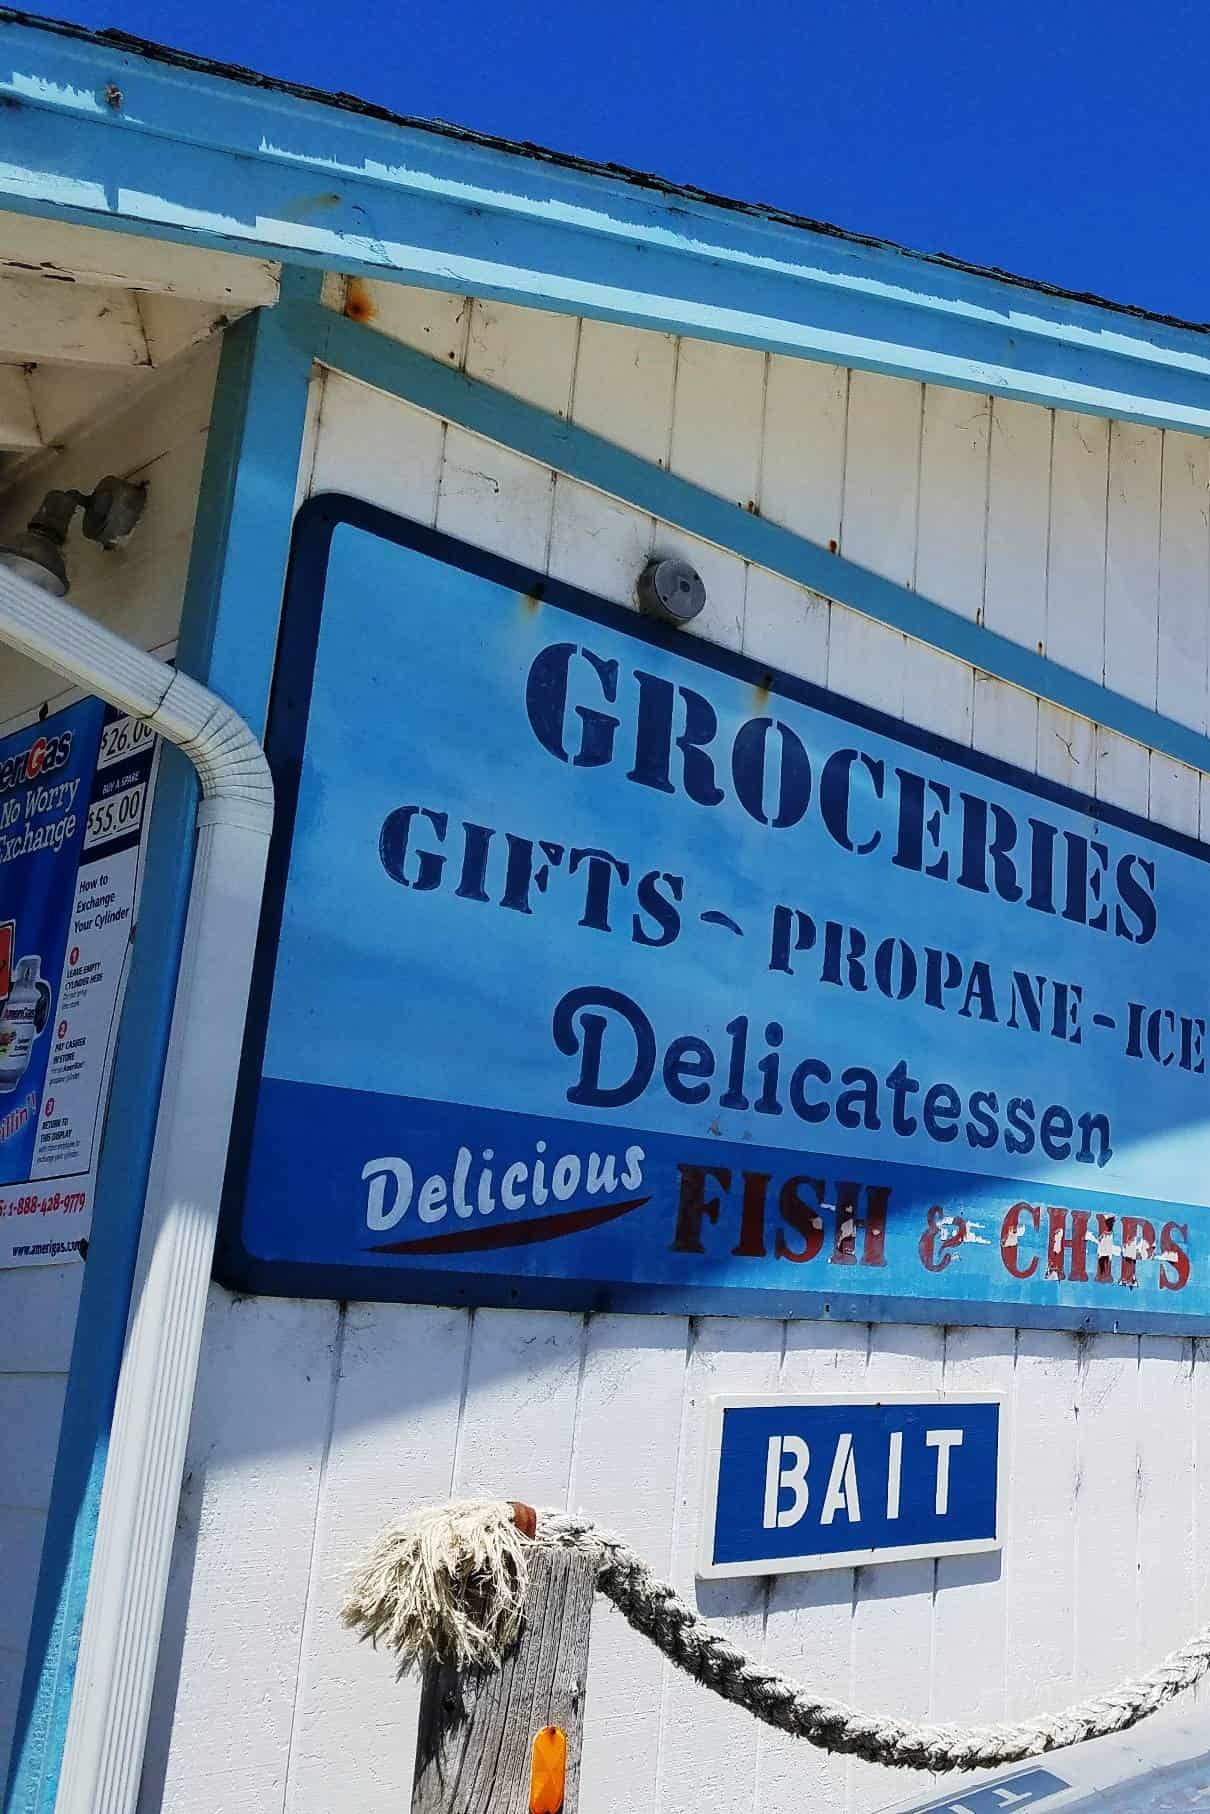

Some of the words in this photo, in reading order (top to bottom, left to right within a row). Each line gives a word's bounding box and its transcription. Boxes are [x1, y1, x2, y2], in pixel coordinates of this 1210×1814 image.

[25, 778, 80, 818] Worry
[87, 790, 140, 836] $55.00
[525, 642, 1158, 946] GROCERIES
[74, 915, 94, 933] Your
[94, 907, 130, 929] Cylinder
[76, 892, 116, 913] Exchange
[79, 876, 99, 893] How
[99, 874, 109, 886] to
[378, 805, 685, 948] GIFTS
[768, 904, 1084, 1046] PROPANE
[1124, 1001, 1207, 1075] ICE
[552, 985, 1113, 1168] Delicatessen
[360, 1140, 646, 1232] Delicious
[668, 1162, 893, 1267] FISH
[917, 1204, 964, 1272] &
[1000, 1201, 1191, 1291] CHIPS
[763, 1429, 963, 1529] BAIT
